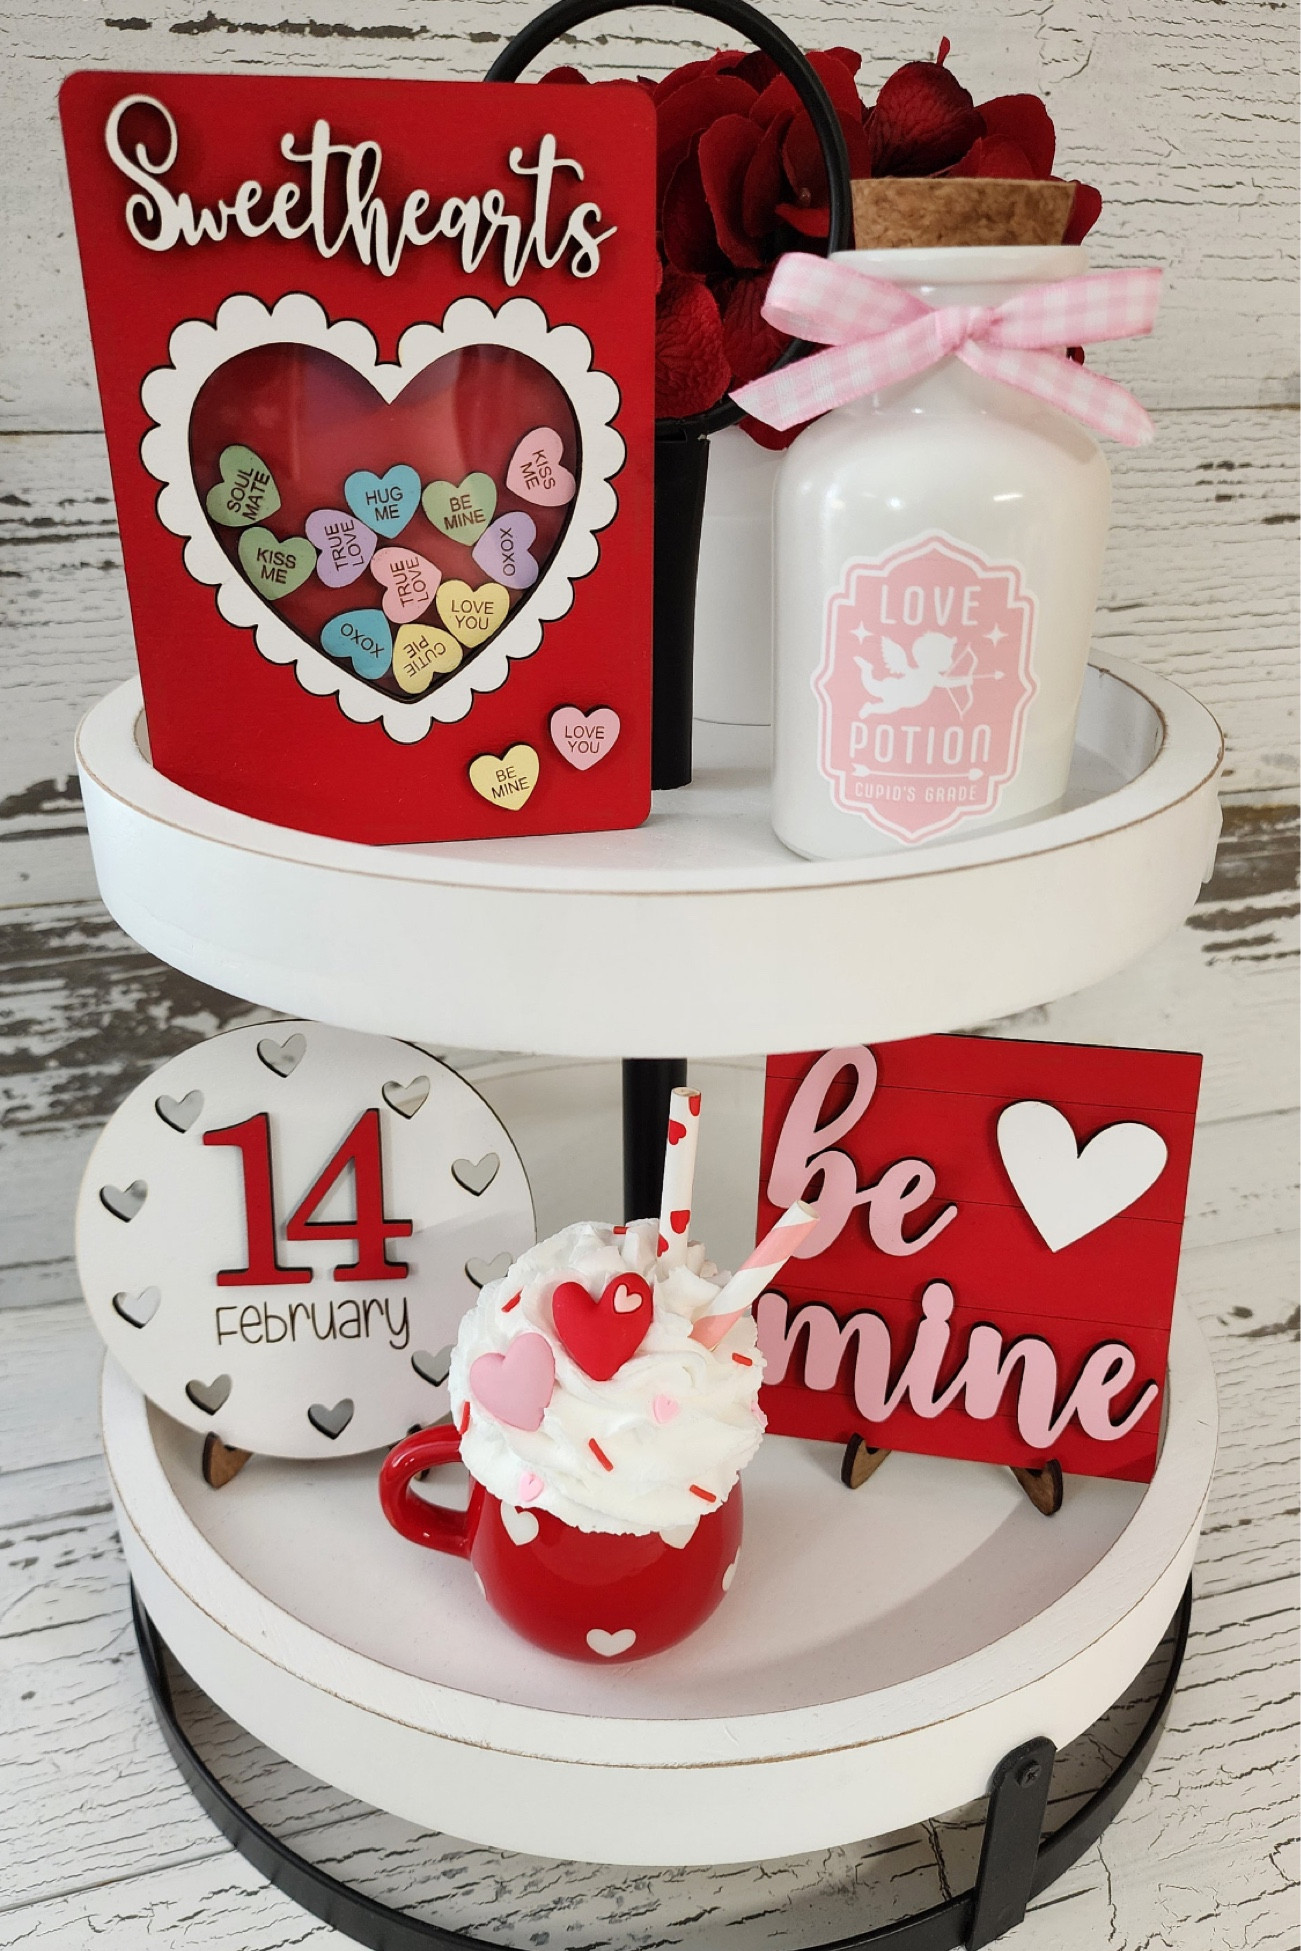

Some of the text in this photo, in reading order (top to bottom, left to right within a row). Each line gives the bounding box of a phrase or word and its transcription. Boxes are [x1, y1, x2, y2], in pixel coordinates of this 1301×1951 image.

[105, 94, 618, 287] Sweethearts
[520, 461, 541, 490] ME
[531, 448, 556, 490] KISS
[226, 467, 255, 512] SOUL
[242, 470, 271, 520] MATE
[365, 486, 404, 506] HUG
[449, 494, 473, 511] BE
[375, 503, 401, 520] ME
[443, 509, 486, 530] MINE
[256, 547, 297, 569] KISS
[324, 525, 350, 571] TRUE
[345, 519, 364, 566] LOVE
[260, 565, 288, 584] ME
[389, 559, 417, 608] TRUE
[410, 556, 430, 602] LOVE
[451, 599, 495, 615] LOVE
[879, 584, 982, 626] LOVE
[455, 614, 490, 630] YOU
[403, 634, 430, 659] PIE
[403, 642, 447, 678] CUTIE
[565, 725, 605, 739] LOVE
[568, 740, 600, 754] YOU
[850, 721, 992, 765] POTION
[491, 777, 531, 799] MINE
[495, 766, 517, 783] BE
[855, 782, 978, 802] CUPID'S GRADE
[767, 1043, 958, 1259] be
[203, 1108, 413, 1286] 14
[216, 1297, 410, 1350] February
[757, 1281, 1159, 1449] mine
